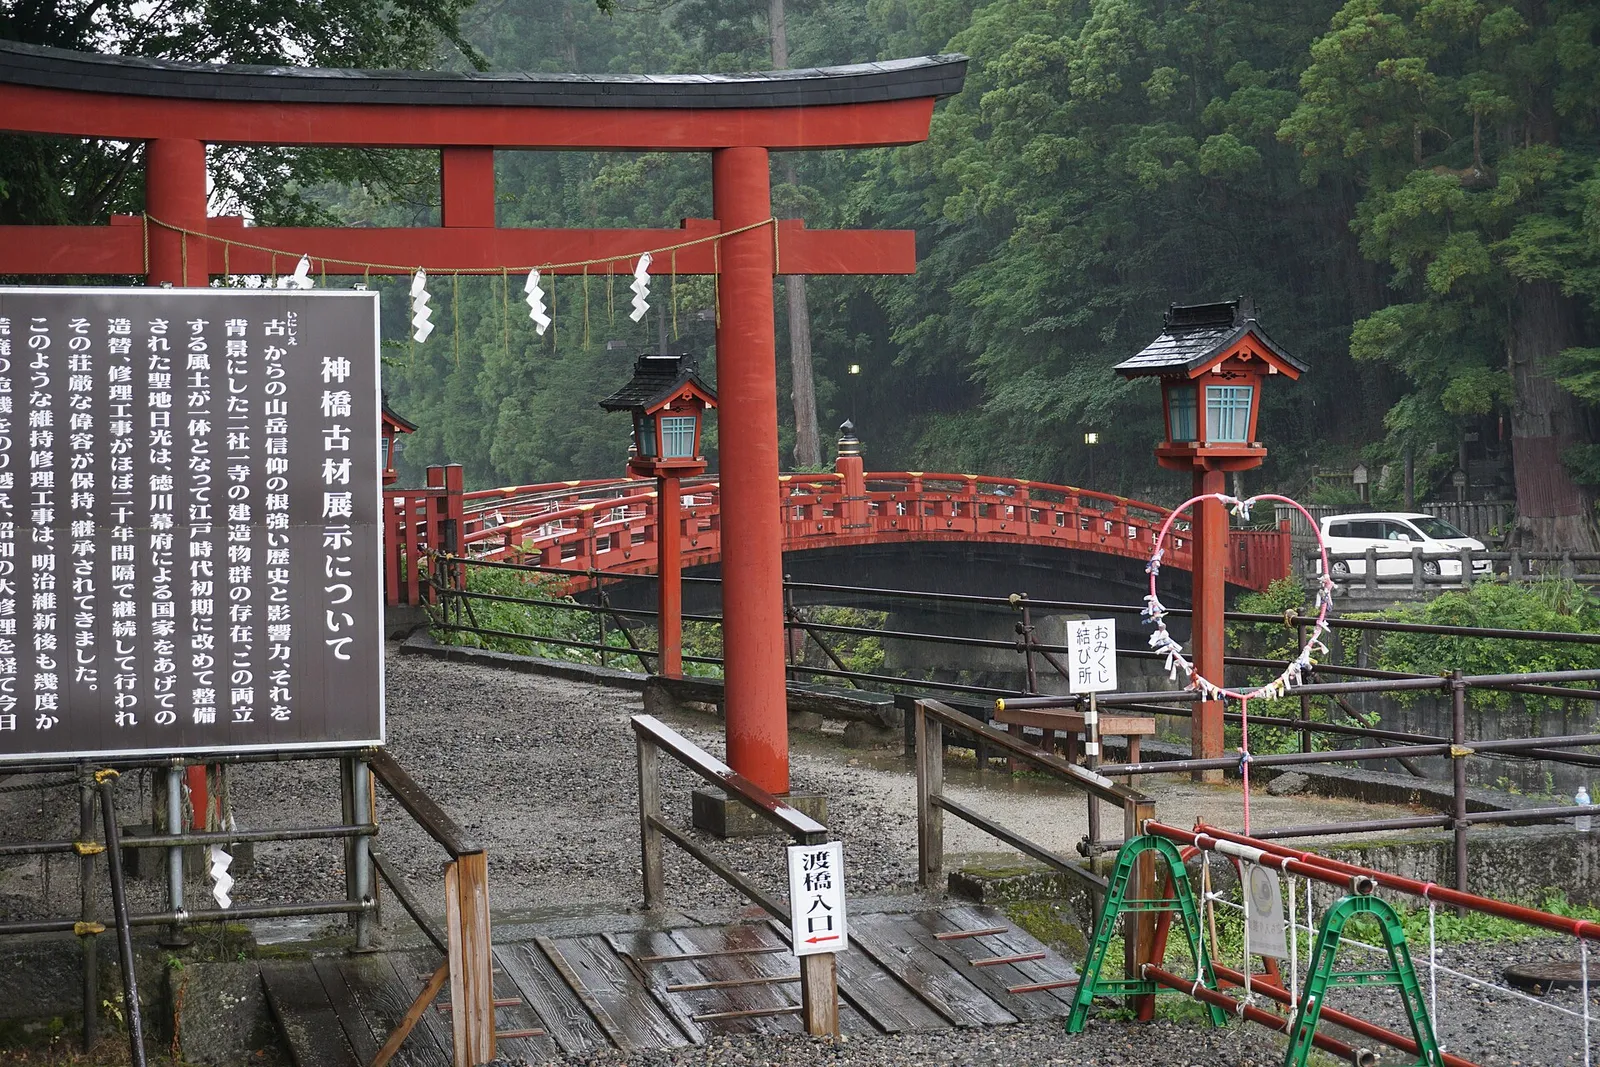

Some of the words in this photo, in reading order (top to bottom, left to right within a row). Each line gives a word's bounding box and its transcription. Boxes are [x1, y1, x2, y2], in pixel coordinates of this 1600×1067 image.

[68, 317, 98, 691] その荘厳な偉容が保持、継承されてきました。
[108, 318, 138, 727] 造替、修理工事がほぼ二十年間隔で継続して行われ
[147, 318, 178, 725] された聖地日光は、徳川幕府による国家をあげての
[186, 318, 217, 725] する風土が一体となって江戸時代初期に改めて整備
[224, 318, 255, 723] 背景にした二社一寺の建造物群の存在、この両立
[263, 318, 292, 721] 古からの山岳信仰の根強い歴史と影響力、それを
[287, 311, 298, 346] いにしえ
[321, 357, 354, 661] 神橋古材展示について
[28, 317, 60, 730] このような維持修理工事は、明治維新後も幾度か
[1076, 627, 1092, 685] 結び所
[1094, 625, 1110, 684] おみくじ
[802, 851, 834, 934] 渡橋入口
